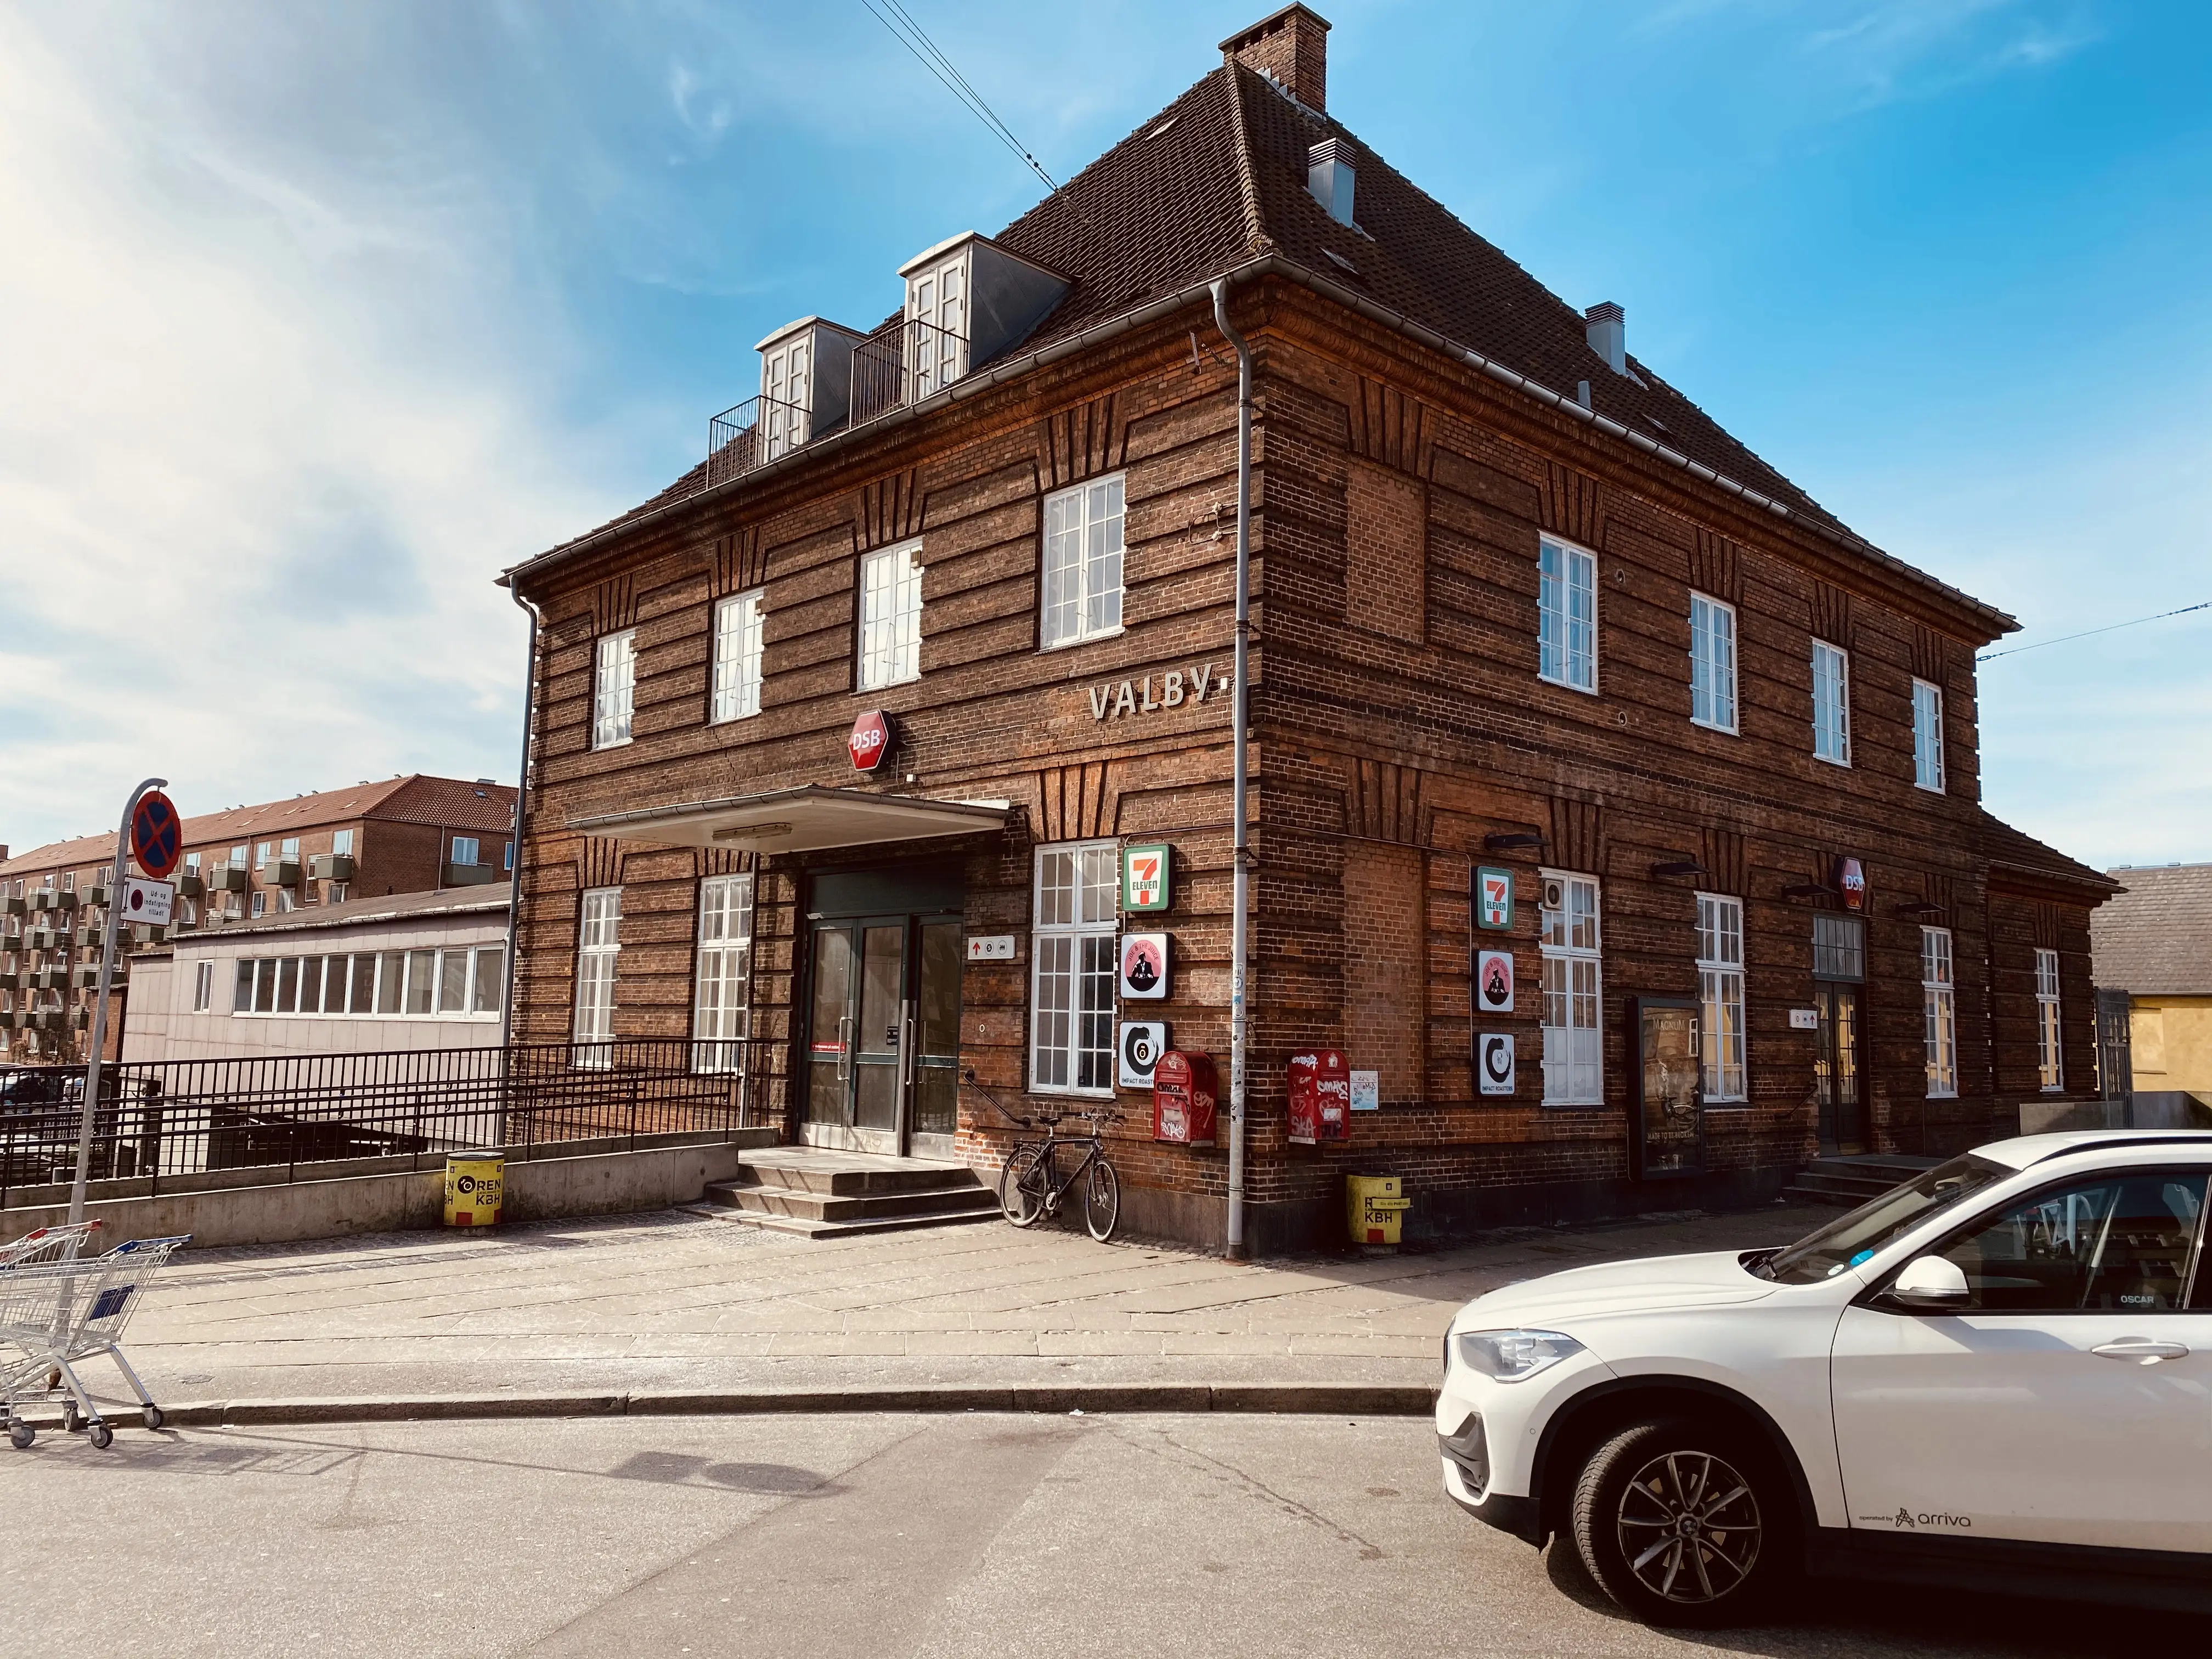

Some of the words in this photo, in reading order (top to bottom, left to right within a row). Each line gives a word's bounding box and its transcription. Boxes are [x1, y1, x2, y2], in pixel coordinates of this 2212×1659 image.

[1089, 664, 1213, 719] VALBY
[853, 729, 881, 751] DSB
[1133, 857, 1158, 905] 7
[1846, 874, 1863, 891] DSB
[1487, 880, 1505, 924] 7
[149, 908, 164, 917] tilladt
[1148, 946, 1159, 961] JUICE
[1500, 963, 1509, 977] JUICE
[1652, 1017, 1685, 1031] MAGNUM
[1674, 1131, 1694, 1139] BROKEN
[477, 1178, 501, 1191] REN
[476, 1193, 500, 1205] KBH
[1364, 1211, 1392, 1223] KBH
[2120, 1295, 2154, 1304] OSCAR
[1918, 1512, 1971, 1527] arriva
